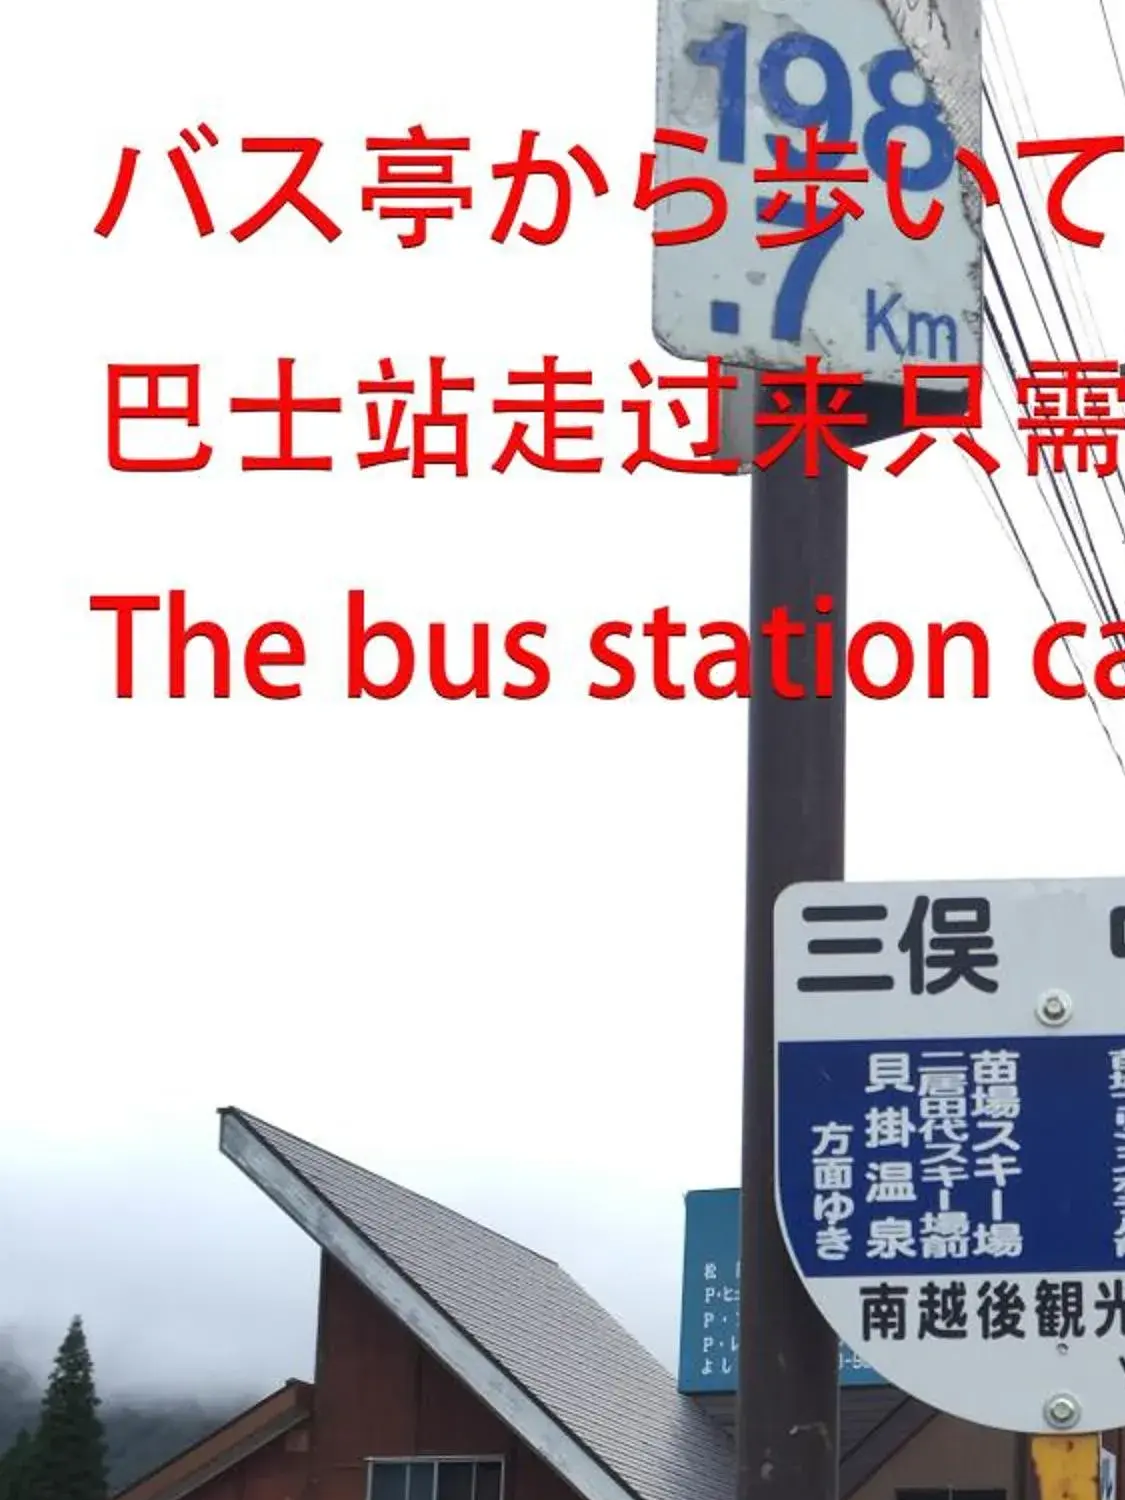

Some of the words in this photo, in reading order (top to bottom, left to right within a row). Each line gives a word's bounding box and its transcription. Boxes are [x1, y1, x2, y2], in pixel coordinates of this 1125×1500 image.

[685, 20, 957, 192] 198
[866, 288, 958, 361] Km
[797, 894, 999, 995] 三俣
[811, 1121, 854, 1260] 方面ゆき
[865, 1052, 917, 1259] 貝掛温泉
[969, 1049, 1023, 1258] 苗場スキー場
